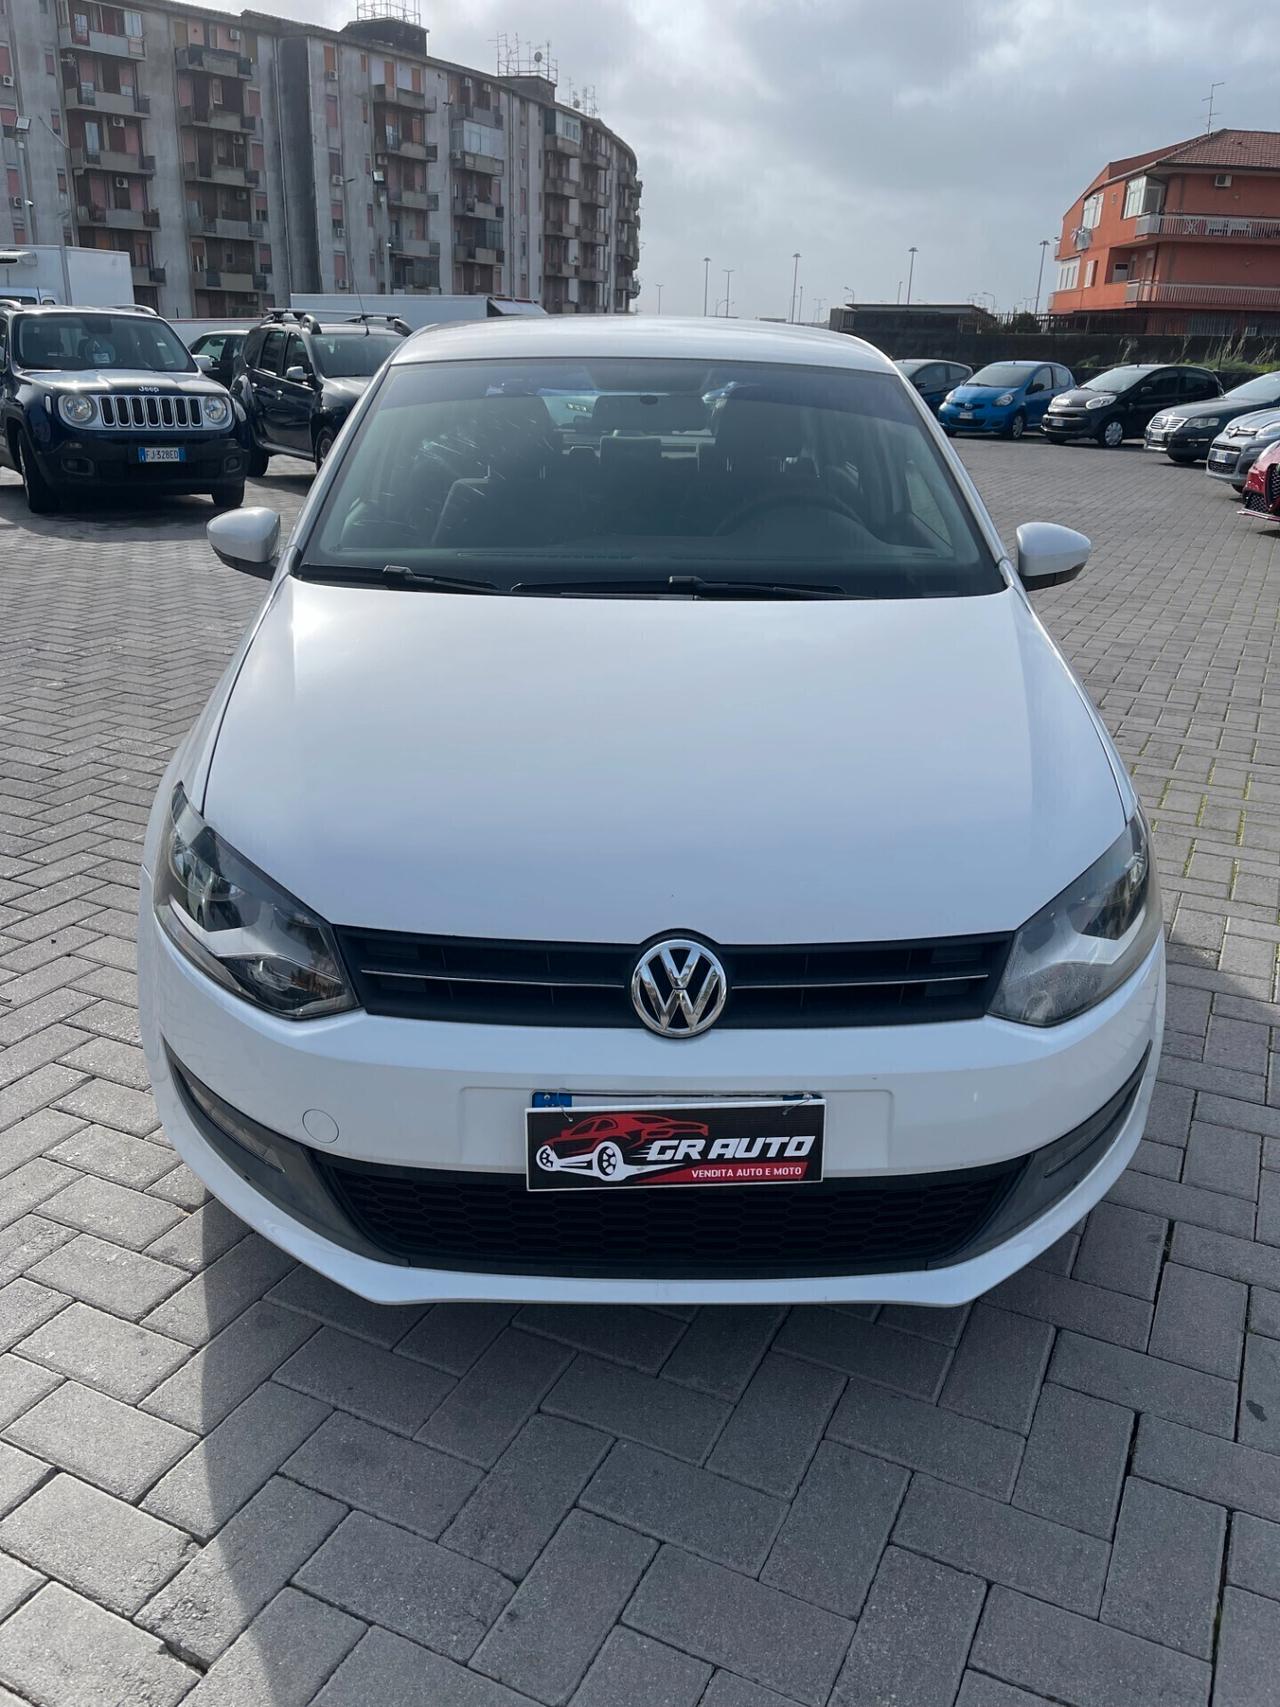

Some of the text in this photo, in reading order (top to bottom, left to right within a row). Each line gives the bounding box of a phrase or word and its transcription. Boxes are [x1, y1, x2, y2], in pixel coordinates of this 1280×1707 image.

[646, 1135, 816, 1160] GR AUTO
[691, 1166, 802, 1178] VENDITA AUTO E MOTO
